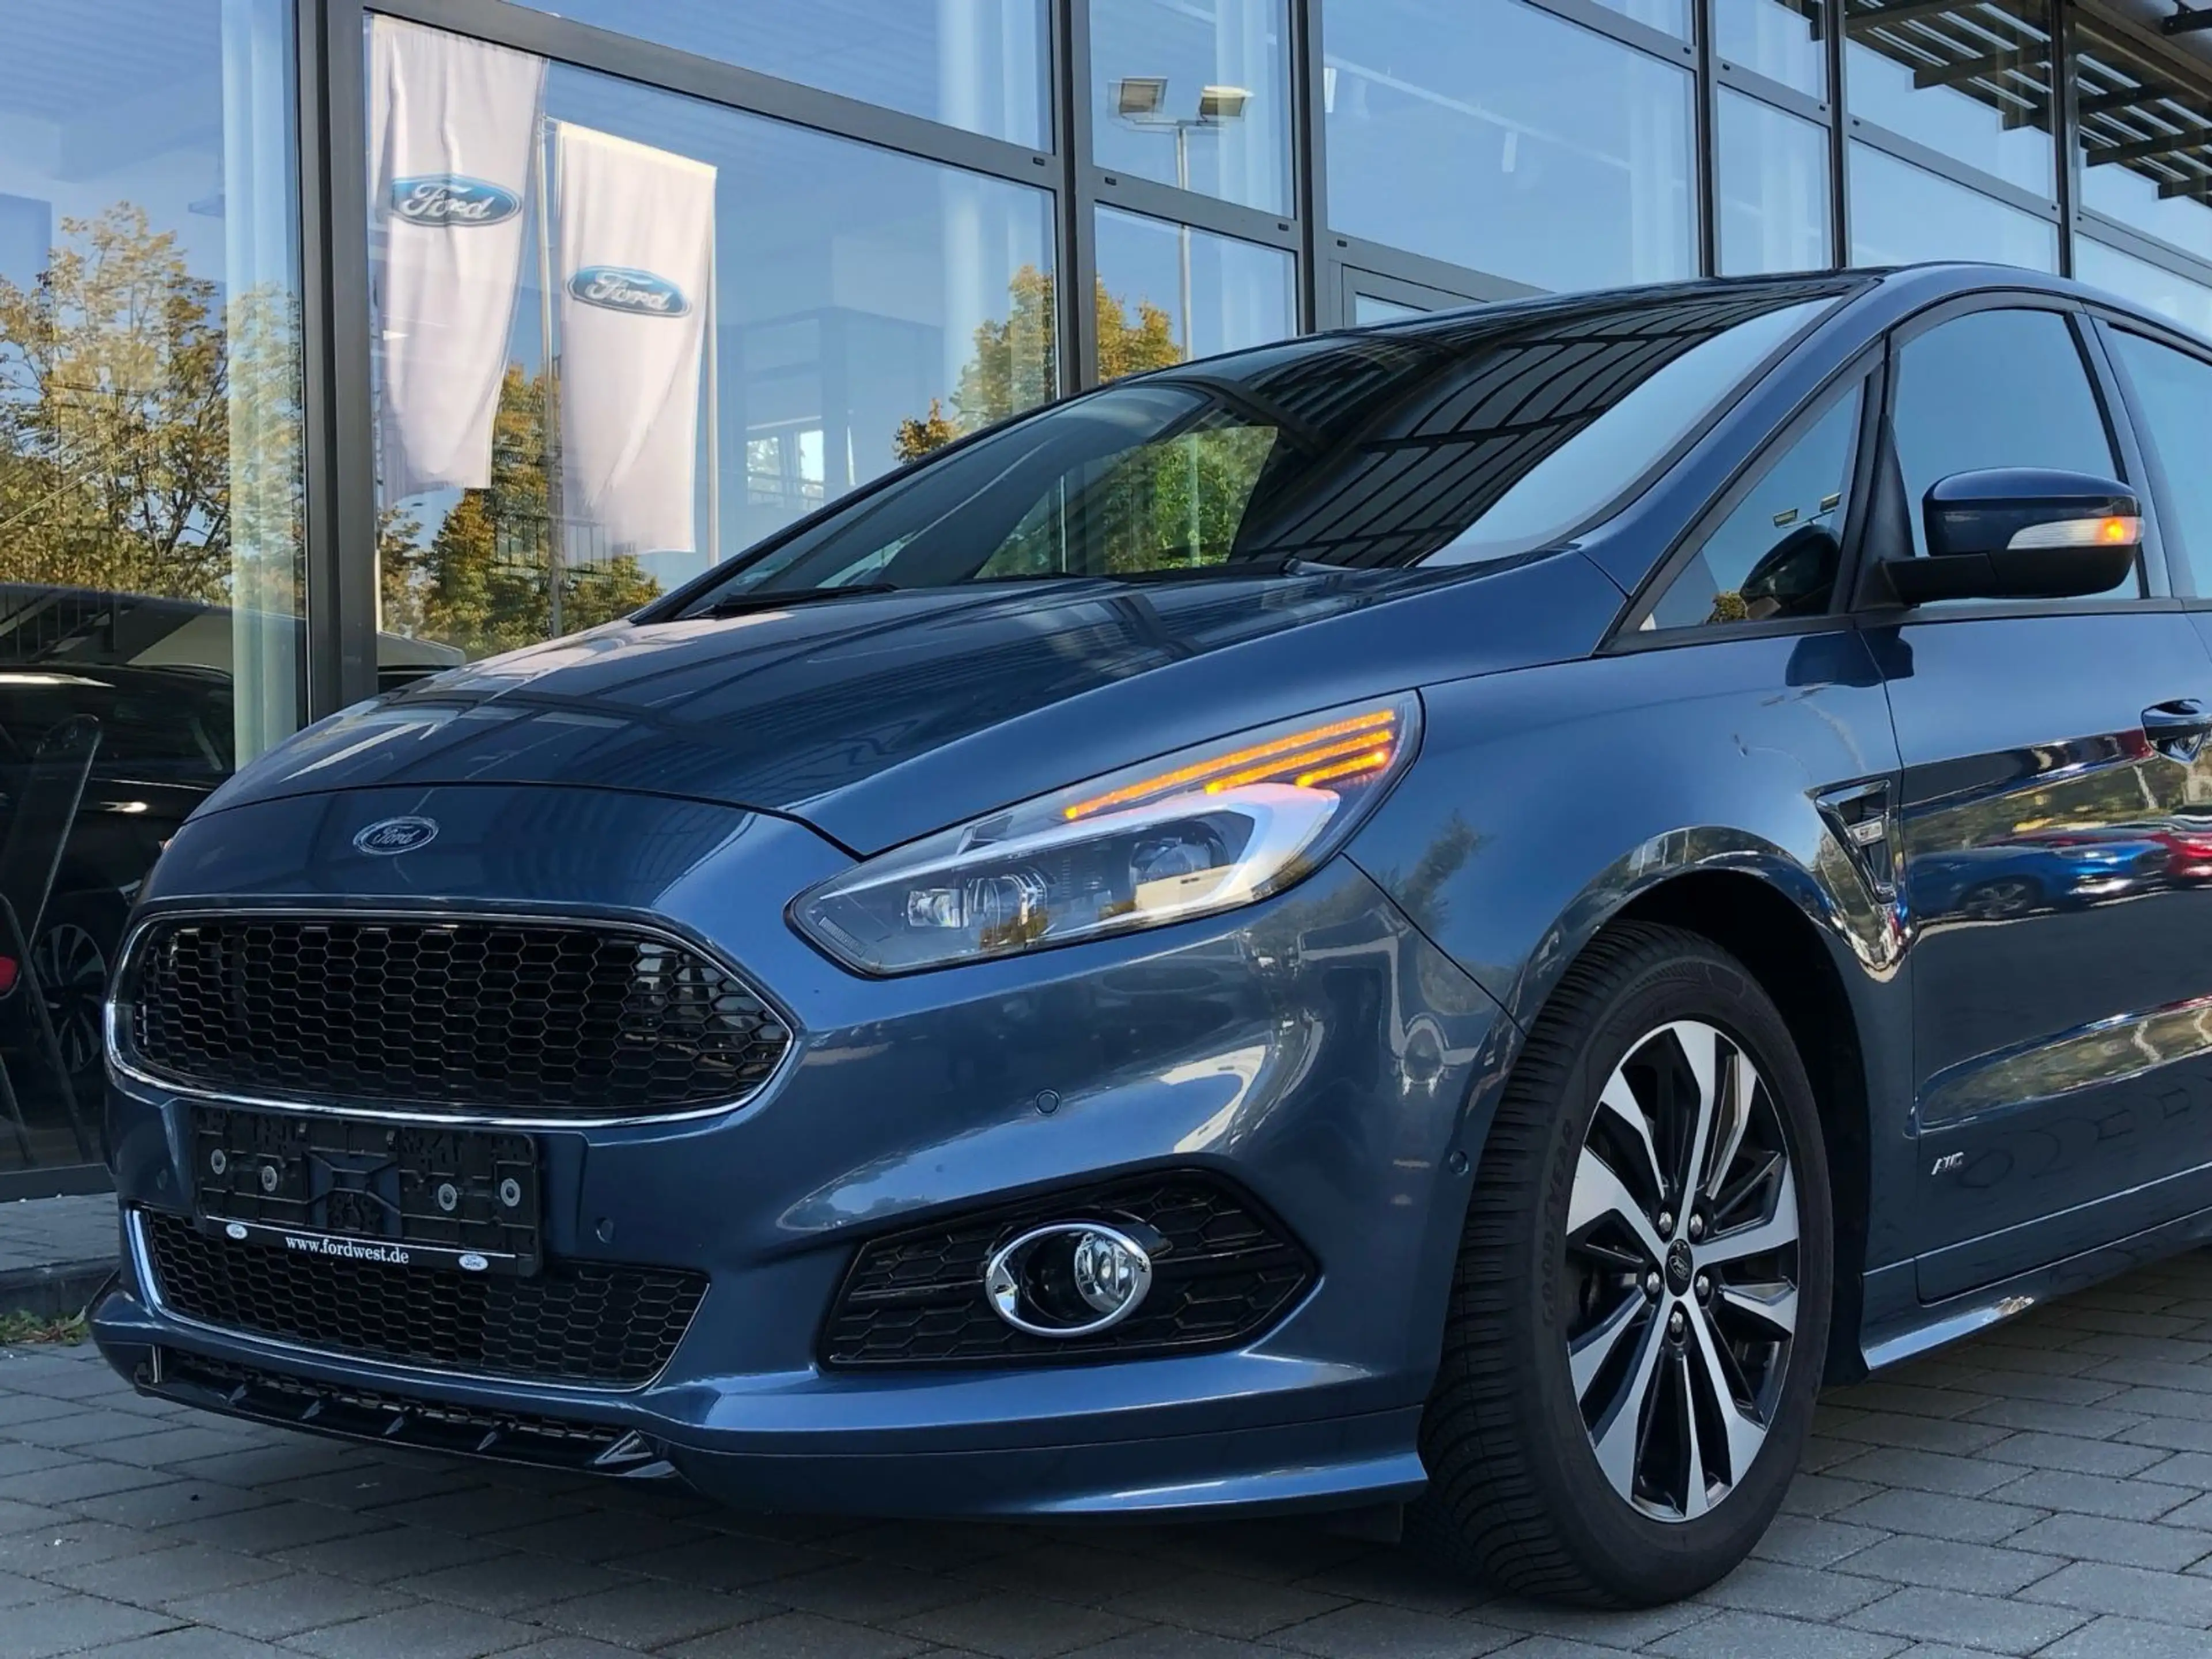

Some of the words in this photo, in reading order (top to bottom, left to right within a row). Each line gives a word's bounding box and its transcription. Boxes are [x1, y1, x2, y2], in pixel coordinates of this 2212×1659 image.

[400, 183, 495, 219] Ford
[585, 272, 671, 310] Ford
[372, 825, 421, 844] Ford
[286, 1236, 409, 1264] www.fordwest.de
